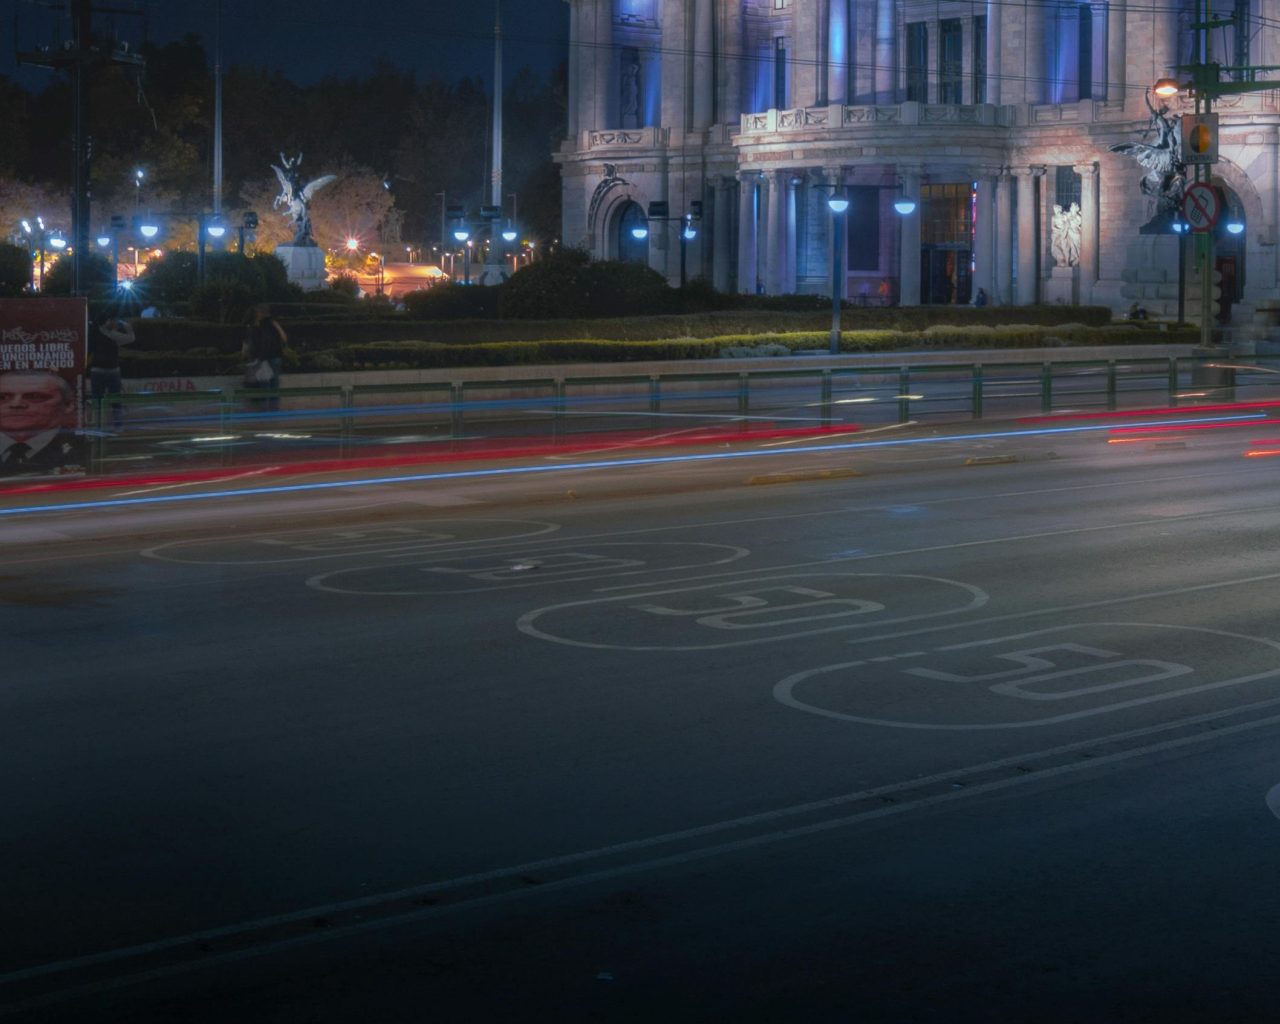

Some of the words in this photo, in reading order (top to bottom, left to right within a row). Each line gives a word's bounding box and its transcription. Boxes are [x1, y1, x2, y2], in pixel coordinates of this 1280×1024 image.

[15, 360, 29, 370] EN
[630, 584, 886, 630] 50
[902, 632, 1196, 701] 50
